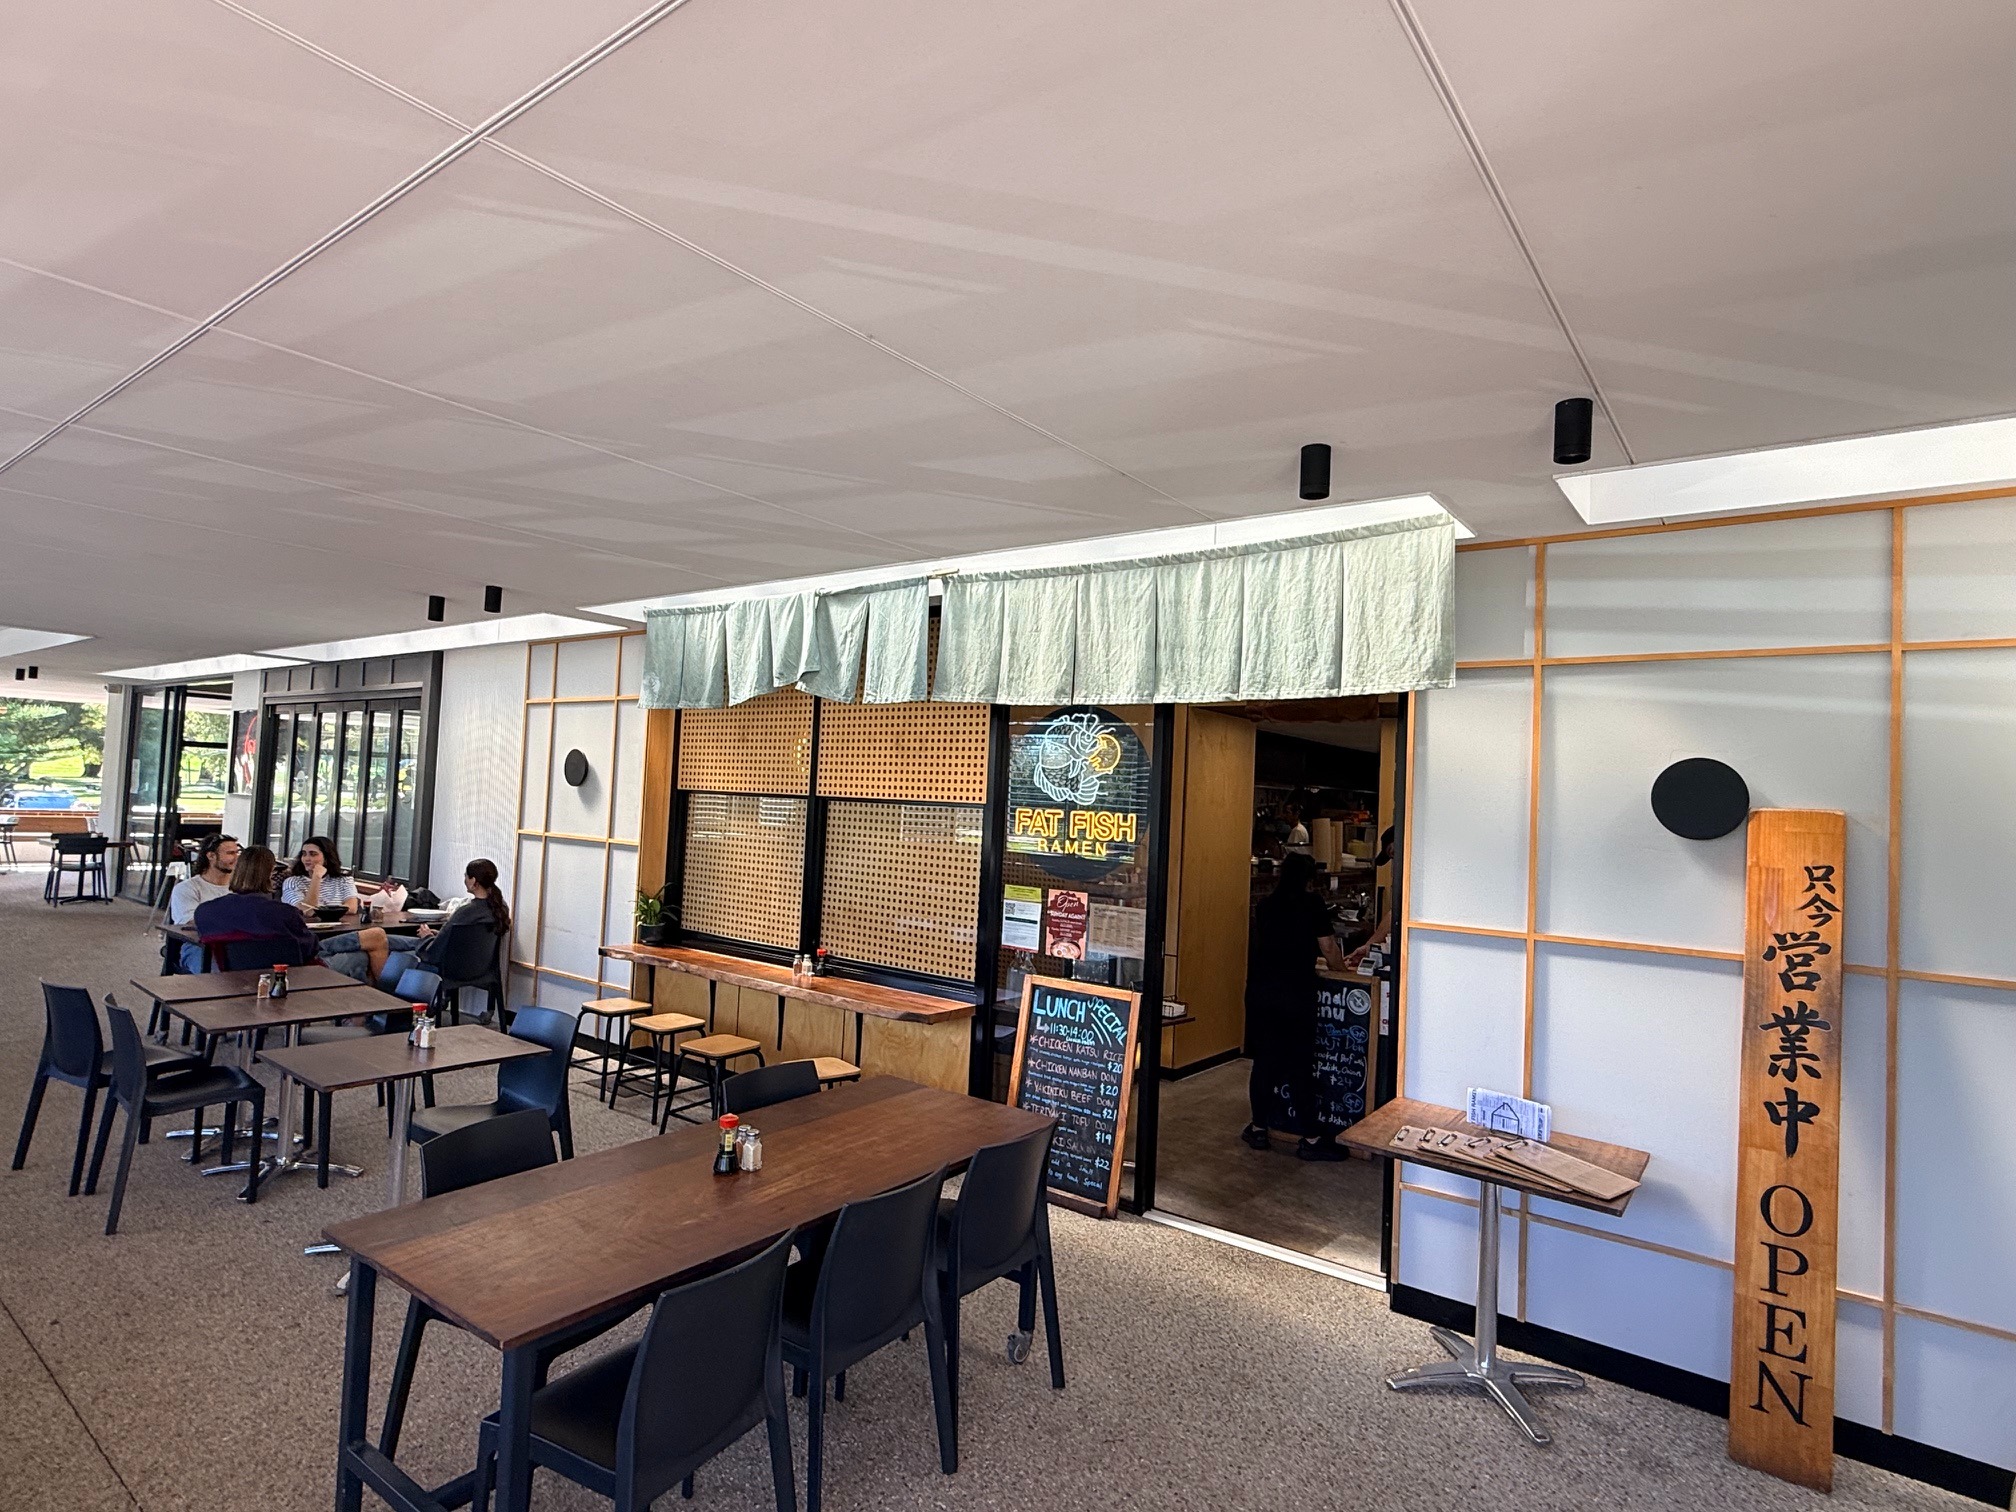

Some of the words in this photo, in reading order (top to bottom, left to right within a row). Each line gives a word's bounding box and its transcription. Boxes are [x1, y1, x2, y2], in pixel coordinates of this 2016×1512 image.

[1014, 808, 1064, 837] FAT
[1069, 811, 1137, 842] FISH
[1037, 838, 1107, 857] RAMEN
[1796, 864, 1841, 928] 只今
[1033, 989, 1086, 1023] LUNCH
[1087, 996, 1127, 1047] SPECIAL
[1049, 1022, 1094, 1041] 11:30-14:00
[1038, 1035, 1073, 1053] CHICKEN
[1075, 1045, 1100, 1059] KATSU
[1102, 1049, 1125, 1062] RICE
[1758, 930, 1833, 1159] 営業中
[1035, 1059, 1067, 1075] CHICKEN
[1069, 1066, 1098, 1080] NANBAN
[1100, 1072, 1118, 1084] DON
[1107, 1061, 1123, 1074] $20
[1099, 1083, 1119, 1097] $20
[1071, 1091, 1093, 1104] BEEF
[1096, 1097, 1115, 1109] DON
[1072, 1114, 1091, 1127] TOFU
[1102, 1108, 1117, 1122] $21
[1095, 1131, 1112, 1145] $19
[1094, 1156, 1110, 1171] $22
[1749, 1184, 1814, 1429] OPEN
